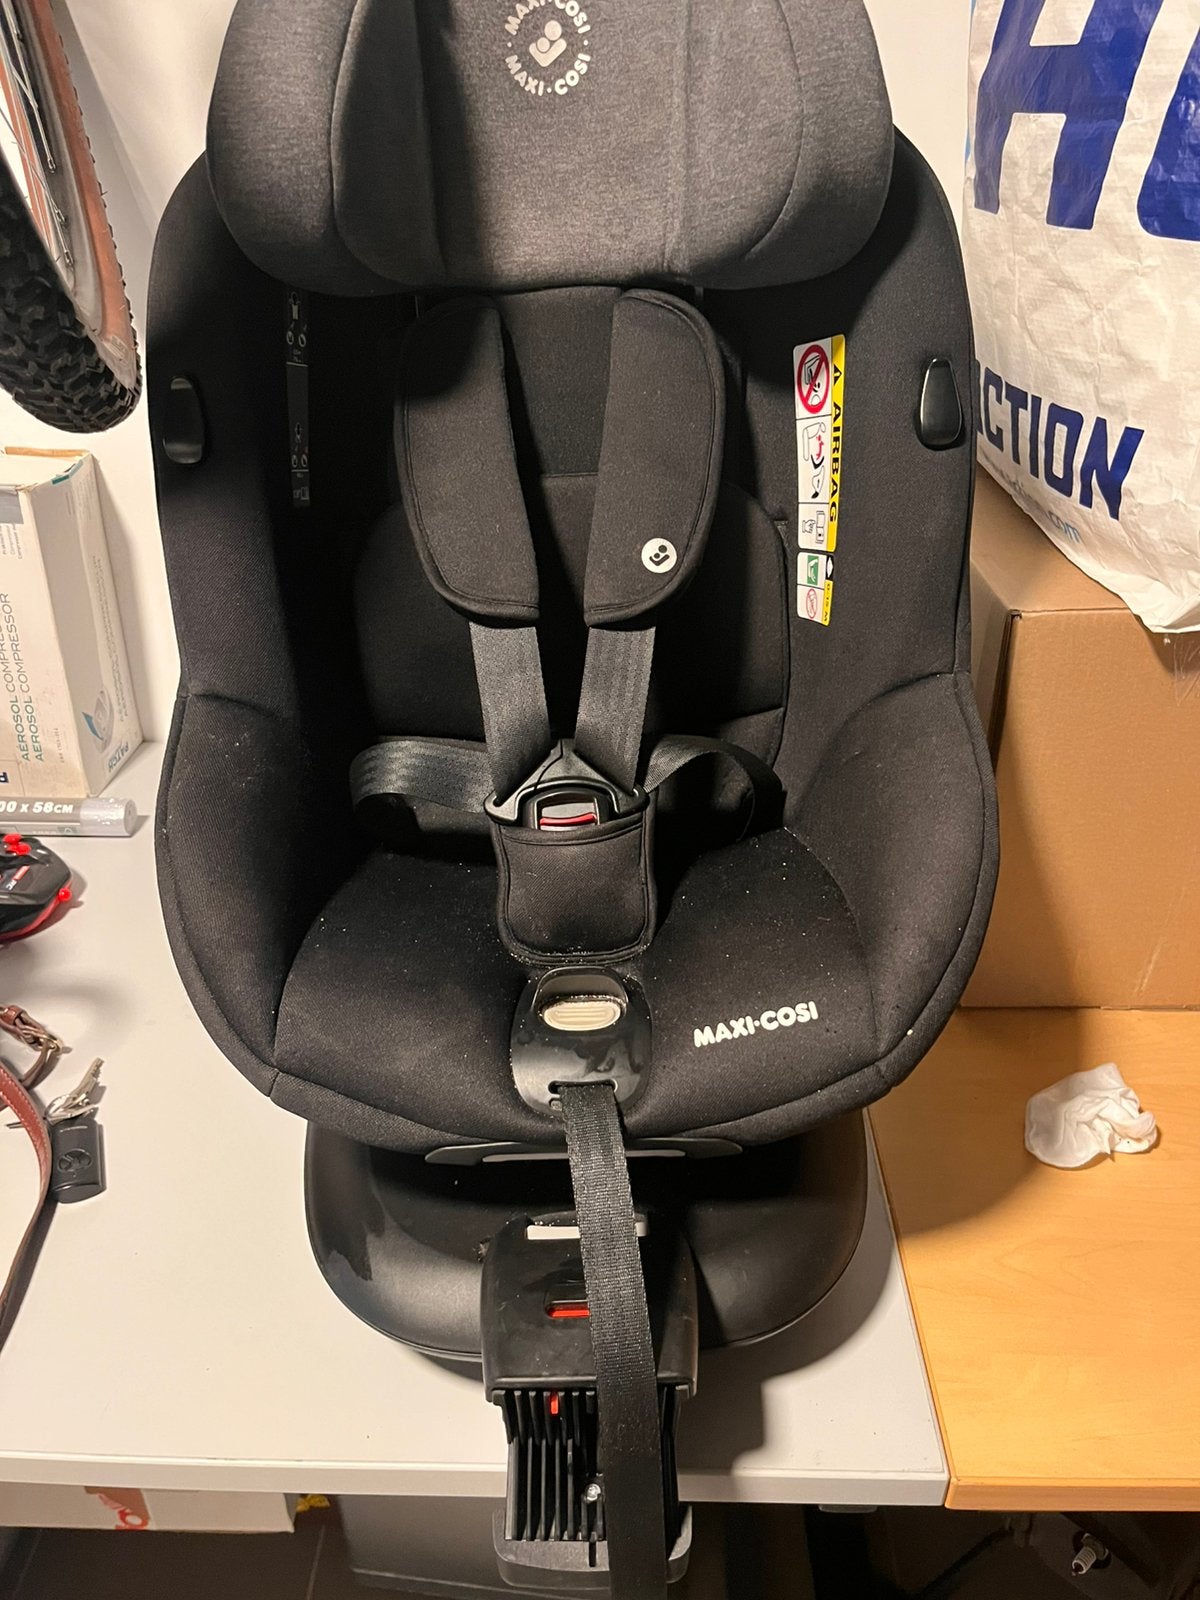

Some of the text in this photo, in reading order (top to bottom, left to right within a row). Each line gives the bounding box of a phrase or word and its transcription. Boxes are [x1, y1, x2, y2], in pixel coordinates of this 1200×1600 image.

[829, 401, 843, 523] AIRBAG
[0, 592, 44, 762] AEROSOL COMPRESSOR
[10, 695, 30, 762] AÉROSOL
